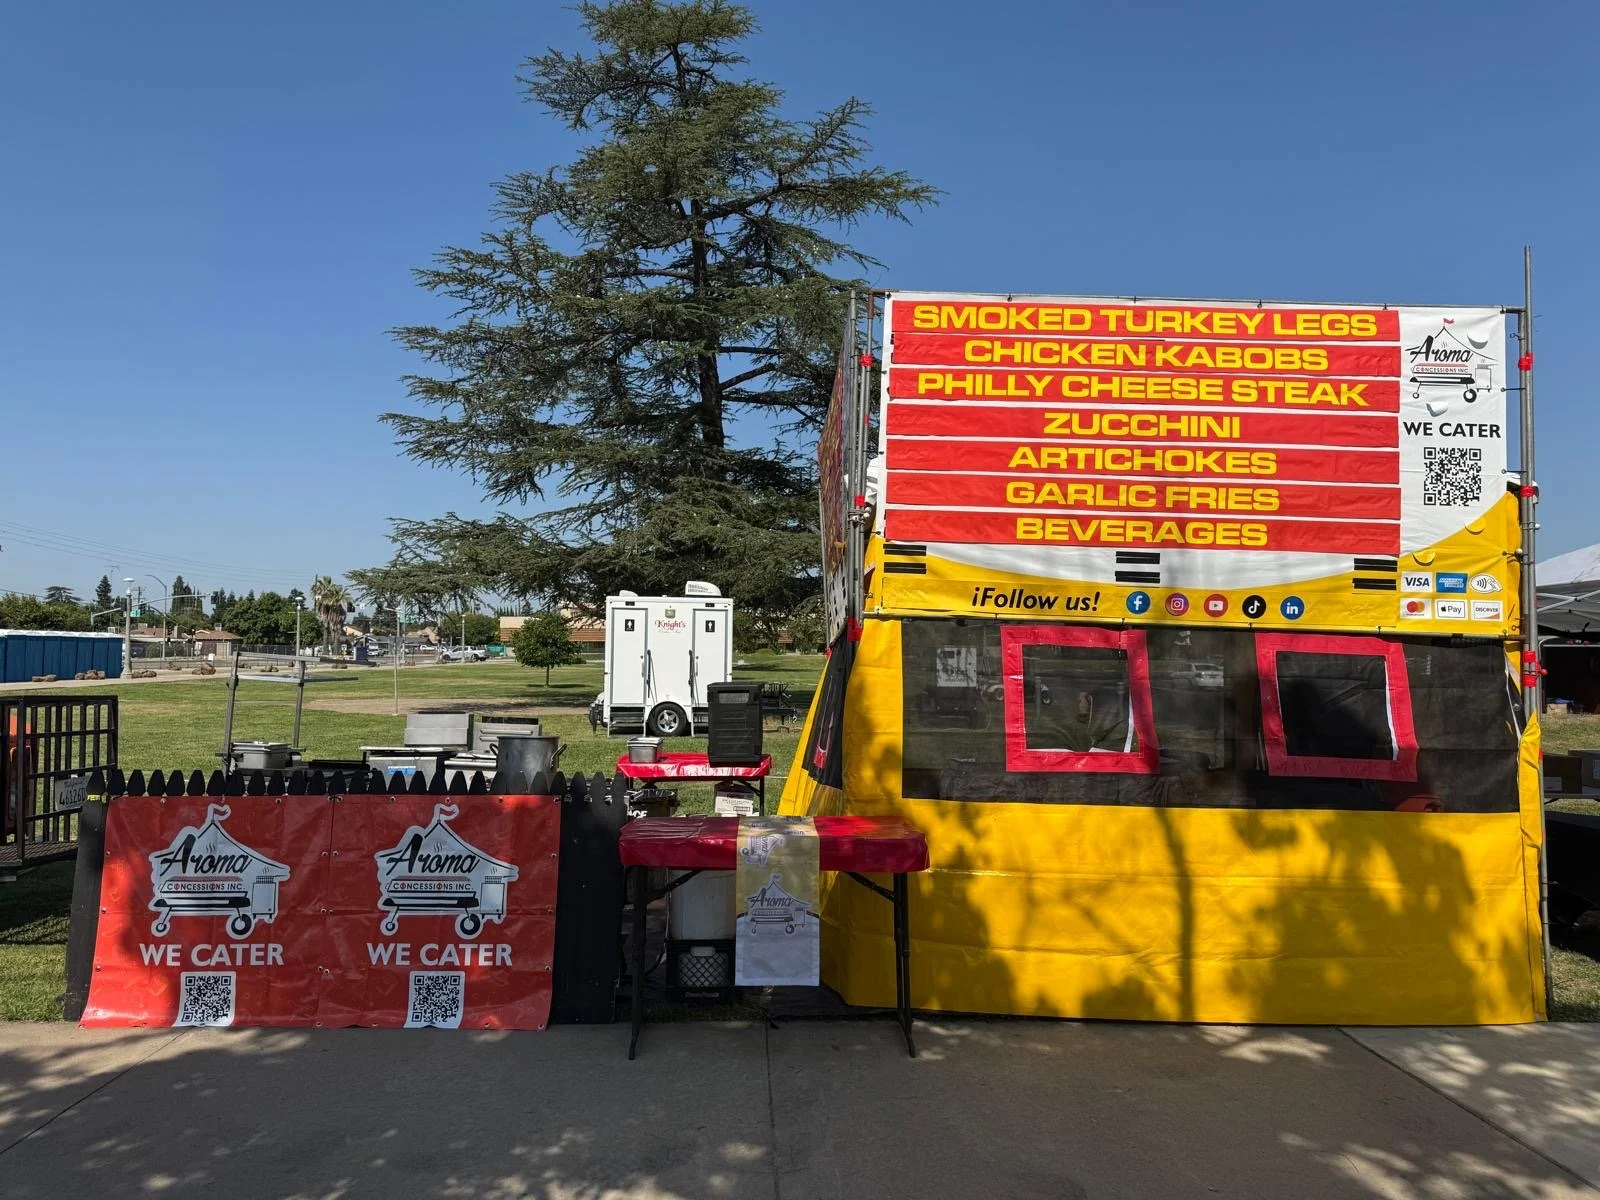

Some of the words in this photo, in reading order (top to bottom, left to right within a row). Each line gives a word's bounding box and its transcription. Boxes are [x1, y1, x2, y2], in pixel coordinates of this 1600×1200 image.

[913, 305, 1092, 331] SMOKED
[1100, 309, 1265, 335] TURKEY
[1273, 313, 1377, 337] LEGS
[964, 339, 1146, 366] CHICKEN
[1155, 344, 1329, 371] KABOBS
[1407, 335, 1474, 363] Aroma
[917, 372, 1054, 397] PHILLY
[1061, 375, 1224, 401] CHEESE
[1231, 379, 1369, 406] STEAK
[1043, 412, 1241, 439] ZUCCHINI
[1403, 422, 1433, 436] WE
[1439, 422, 1502, 438] CATER
[1008, 446, 1278, 475] ARTICHOKES
[1006, 481, 1157, 508] GARLIC
[1165, 486, 1280, 512] FRIES
[1016, 517, 1268, 546] BEVERAGES
[1404, 577, 1430, 587] VISA
[1065, 591, 1100, 612] us!
[1447, 605, 1462, 613] Pay
[655, 619, 687, 631] Knight's
[160, 833, 253, 877] Aroma
[386, 833, 480, 876] Aroma
[749, 888, 794, 908] Aroma
[139, 943, 182, 966] WE
[190, 943, 284, 967] CATER
[366, 943, 411, 966] WE
[420, 943, 513, 967] CATER
